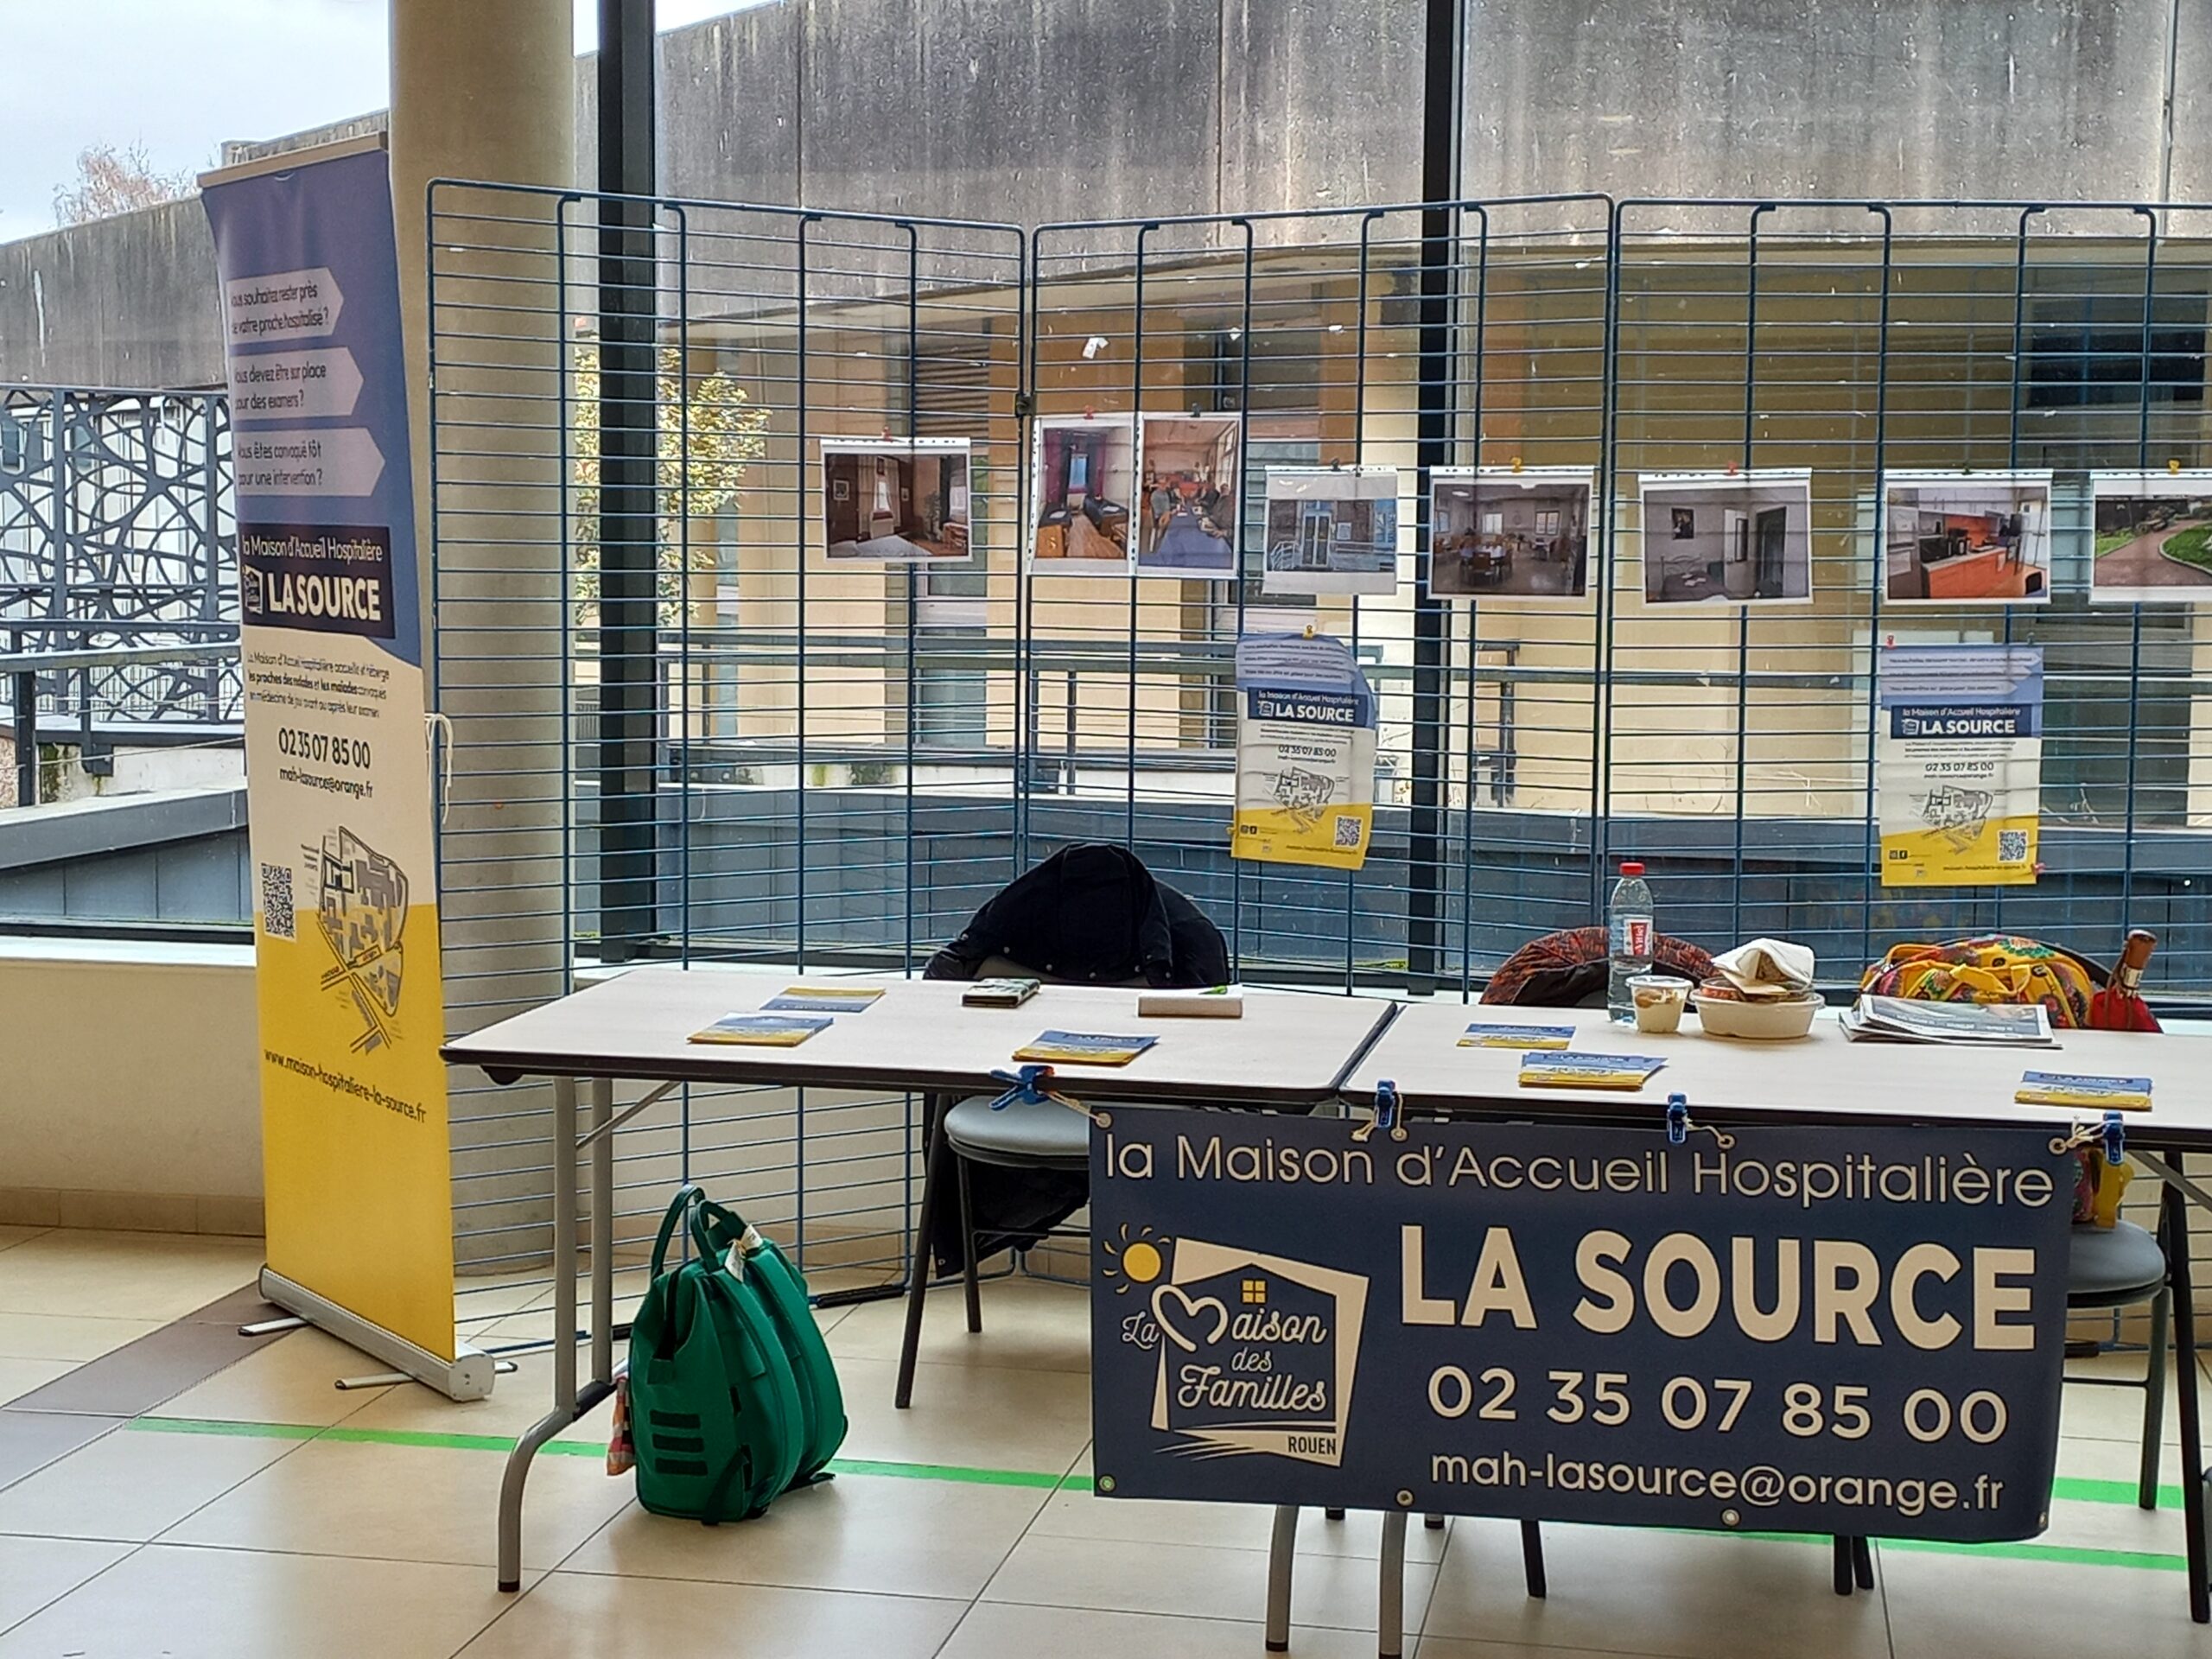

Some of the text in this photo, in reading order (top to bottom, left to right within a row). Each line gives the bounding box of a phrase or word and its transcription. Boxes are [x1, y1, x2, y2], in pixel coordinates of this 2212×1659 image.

[299, 280, 317, 302] près
[250, 365, 274, 382] devez
[302, 360, 326, 383] place
[251, 393, 266, 410] des
[254, 441, 273, 459] êtes
[255, 473, 272, 486] une
[252, 536, 286, 556] Maison
[327, 537, 383, 566] Hospitalière
[268, 572, 296, 614] LA
[296, 575, 381, 621] SOURCE
[1275, 702, 1295, 718] LA
[1296, 704, 1355, 722] SOURCE
[1921, 719, 1944, 735] LA
[1945, 718, 2016, 734] SOURCE
[279, 727, 371, 769] 02 35 07 85 00
[1105, 1133, 2055, 1208] la Maison d'Accueil Hospitalière
[1402, 1224, 2036, 1351] LA SOURCE
[1122, 1309, 1160, 1351] La
[1230, 1346, 1273, 1373] des
[1177, 1364, 1327, 1413] Familles
[1428, 1365, 2009, 1444] 02 35 07 85 00
[1287, 1435, 1338, 1457] ROUEN
[1431, 1452, 2005, 1518] mah-lasource@orange.fr
